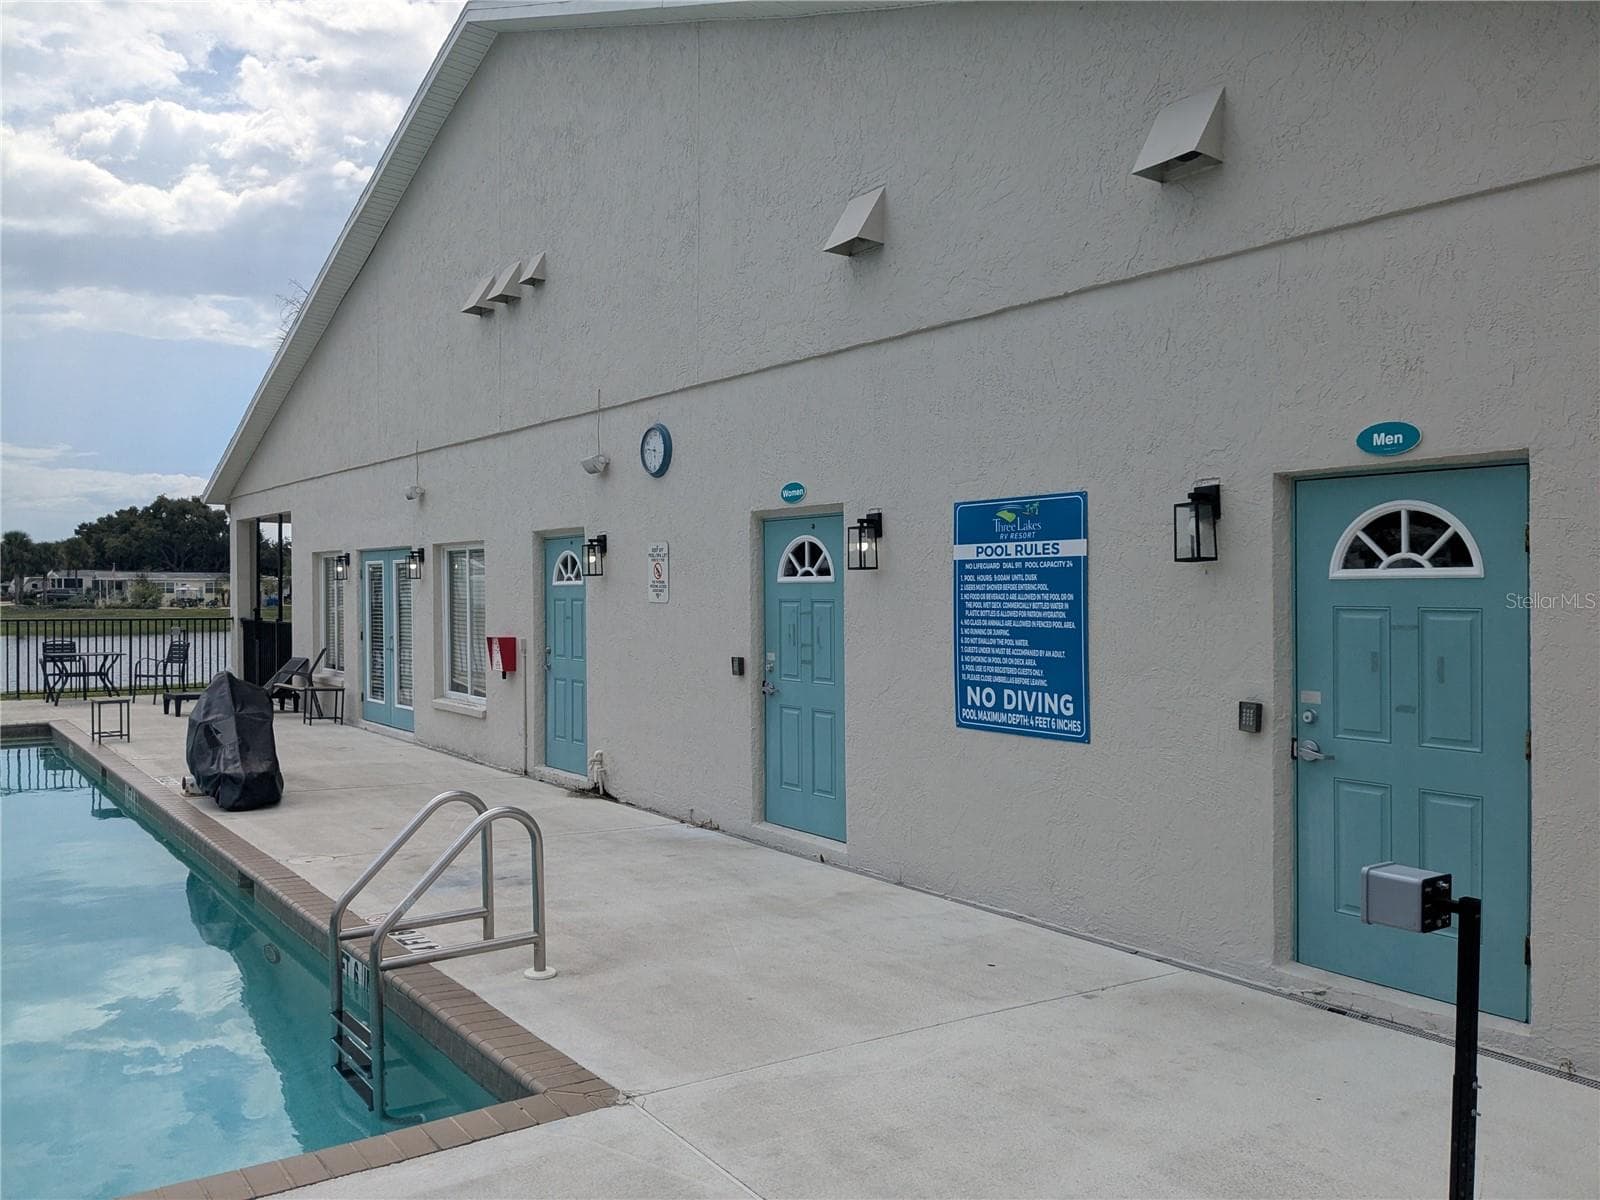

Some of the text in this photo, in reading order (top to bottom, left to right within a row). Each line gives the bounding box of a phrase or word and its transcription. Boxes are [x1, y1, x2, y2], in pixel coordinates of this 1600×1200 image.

[1373, 432, 1403, 446] Men
[782, 488, 804, 498] Women
[992, 516, 1042, 533] Three Lakes
[1011, 532, 1036, 540] RESORT
[976, 542, 1060, 558] POOL RULES
[966, 686, 1074, 716] NO DIVING
[962, 708, 978, 720] POOL
[978, 711, 1007, 723] MAXIMUM
[1030, 716, 1034, 727] 4
[1035, 716, 1050, 729] FEET
[1051, 718, 1056, 730] 6
[1056, 719, 1082, 732] INCHES
